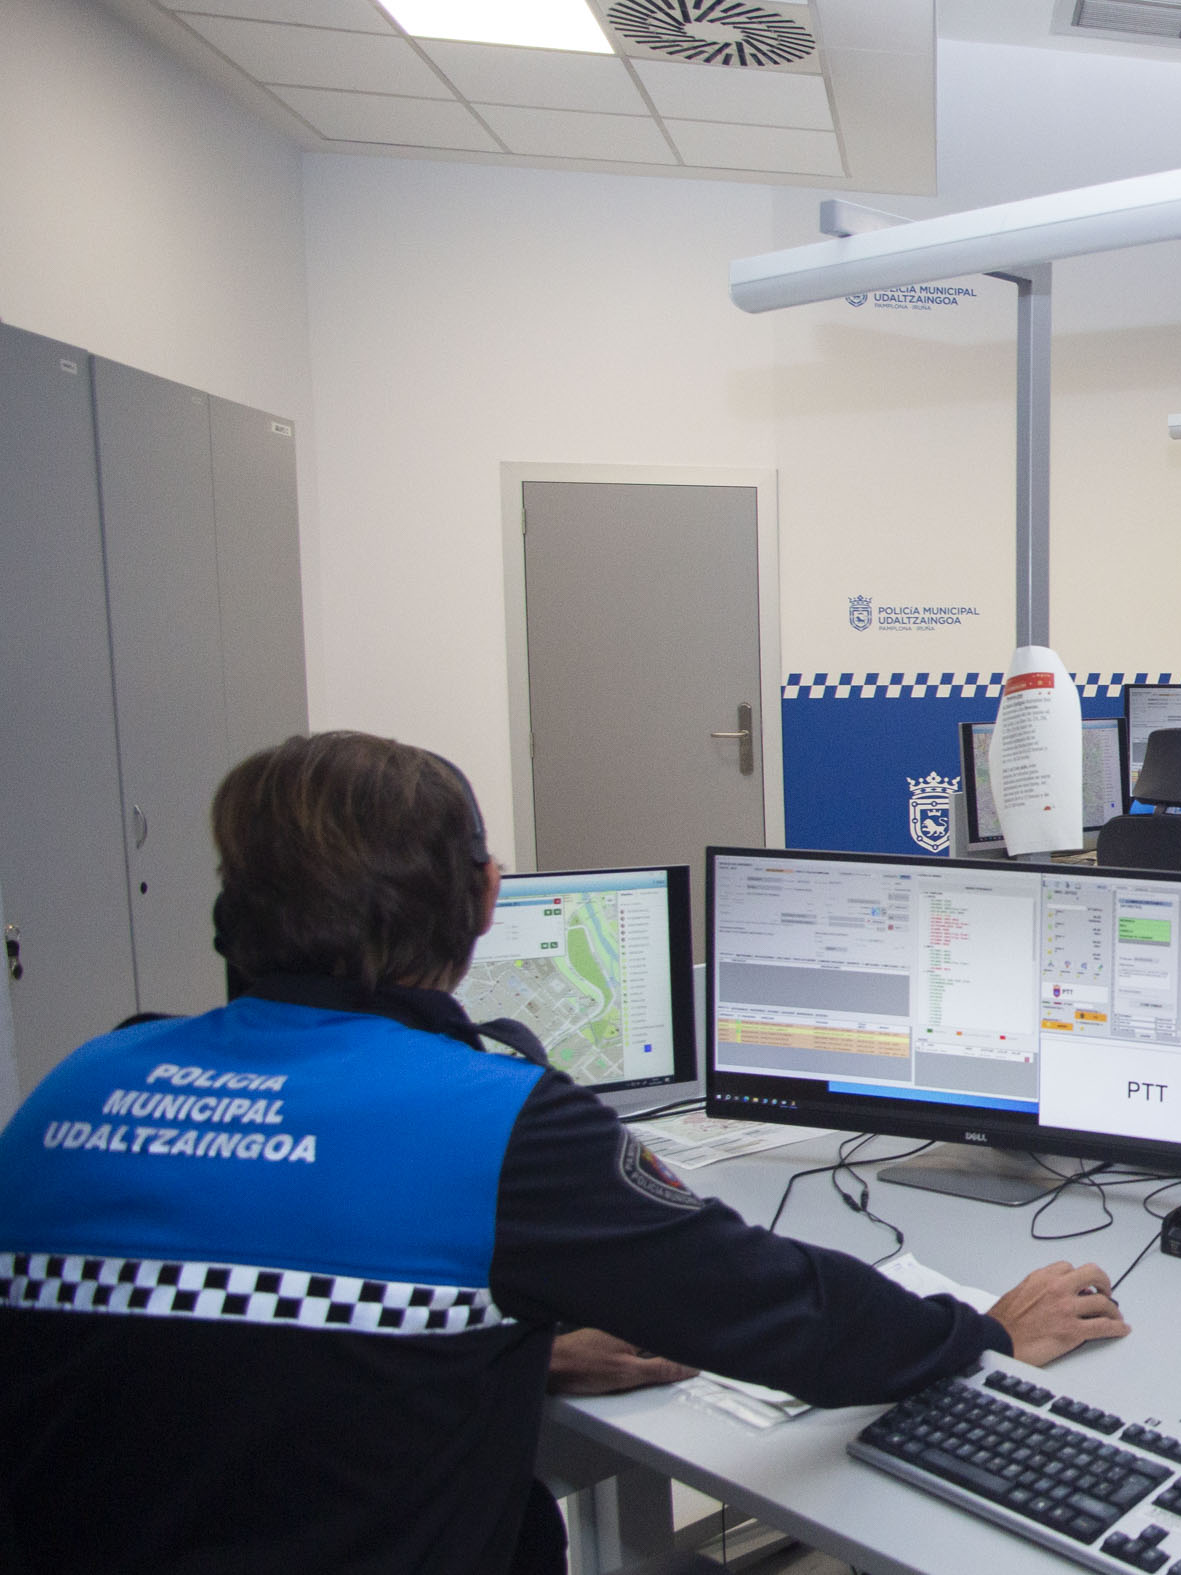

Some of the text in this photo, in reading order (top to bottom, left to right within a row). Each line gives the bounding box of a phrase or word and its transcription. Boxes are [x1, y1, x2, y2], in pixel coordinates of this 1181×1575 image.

[874, 294, 958, 305] UDALTZAINGOA
[920, 286, 977, 297] MUNICIPAL
[923, 607, 980, 616] MUNICIPAL
[878, 616, 962, 625] UDALTZAINGOA
[146, 1064, 288, 1092] POLICIA
[1128, 1081, 1168, 1102] PTT
[102, 1089, 284, 1125] MUNICIPAL
[43, 1121, 318, 1163] UDALTZAINGOA
